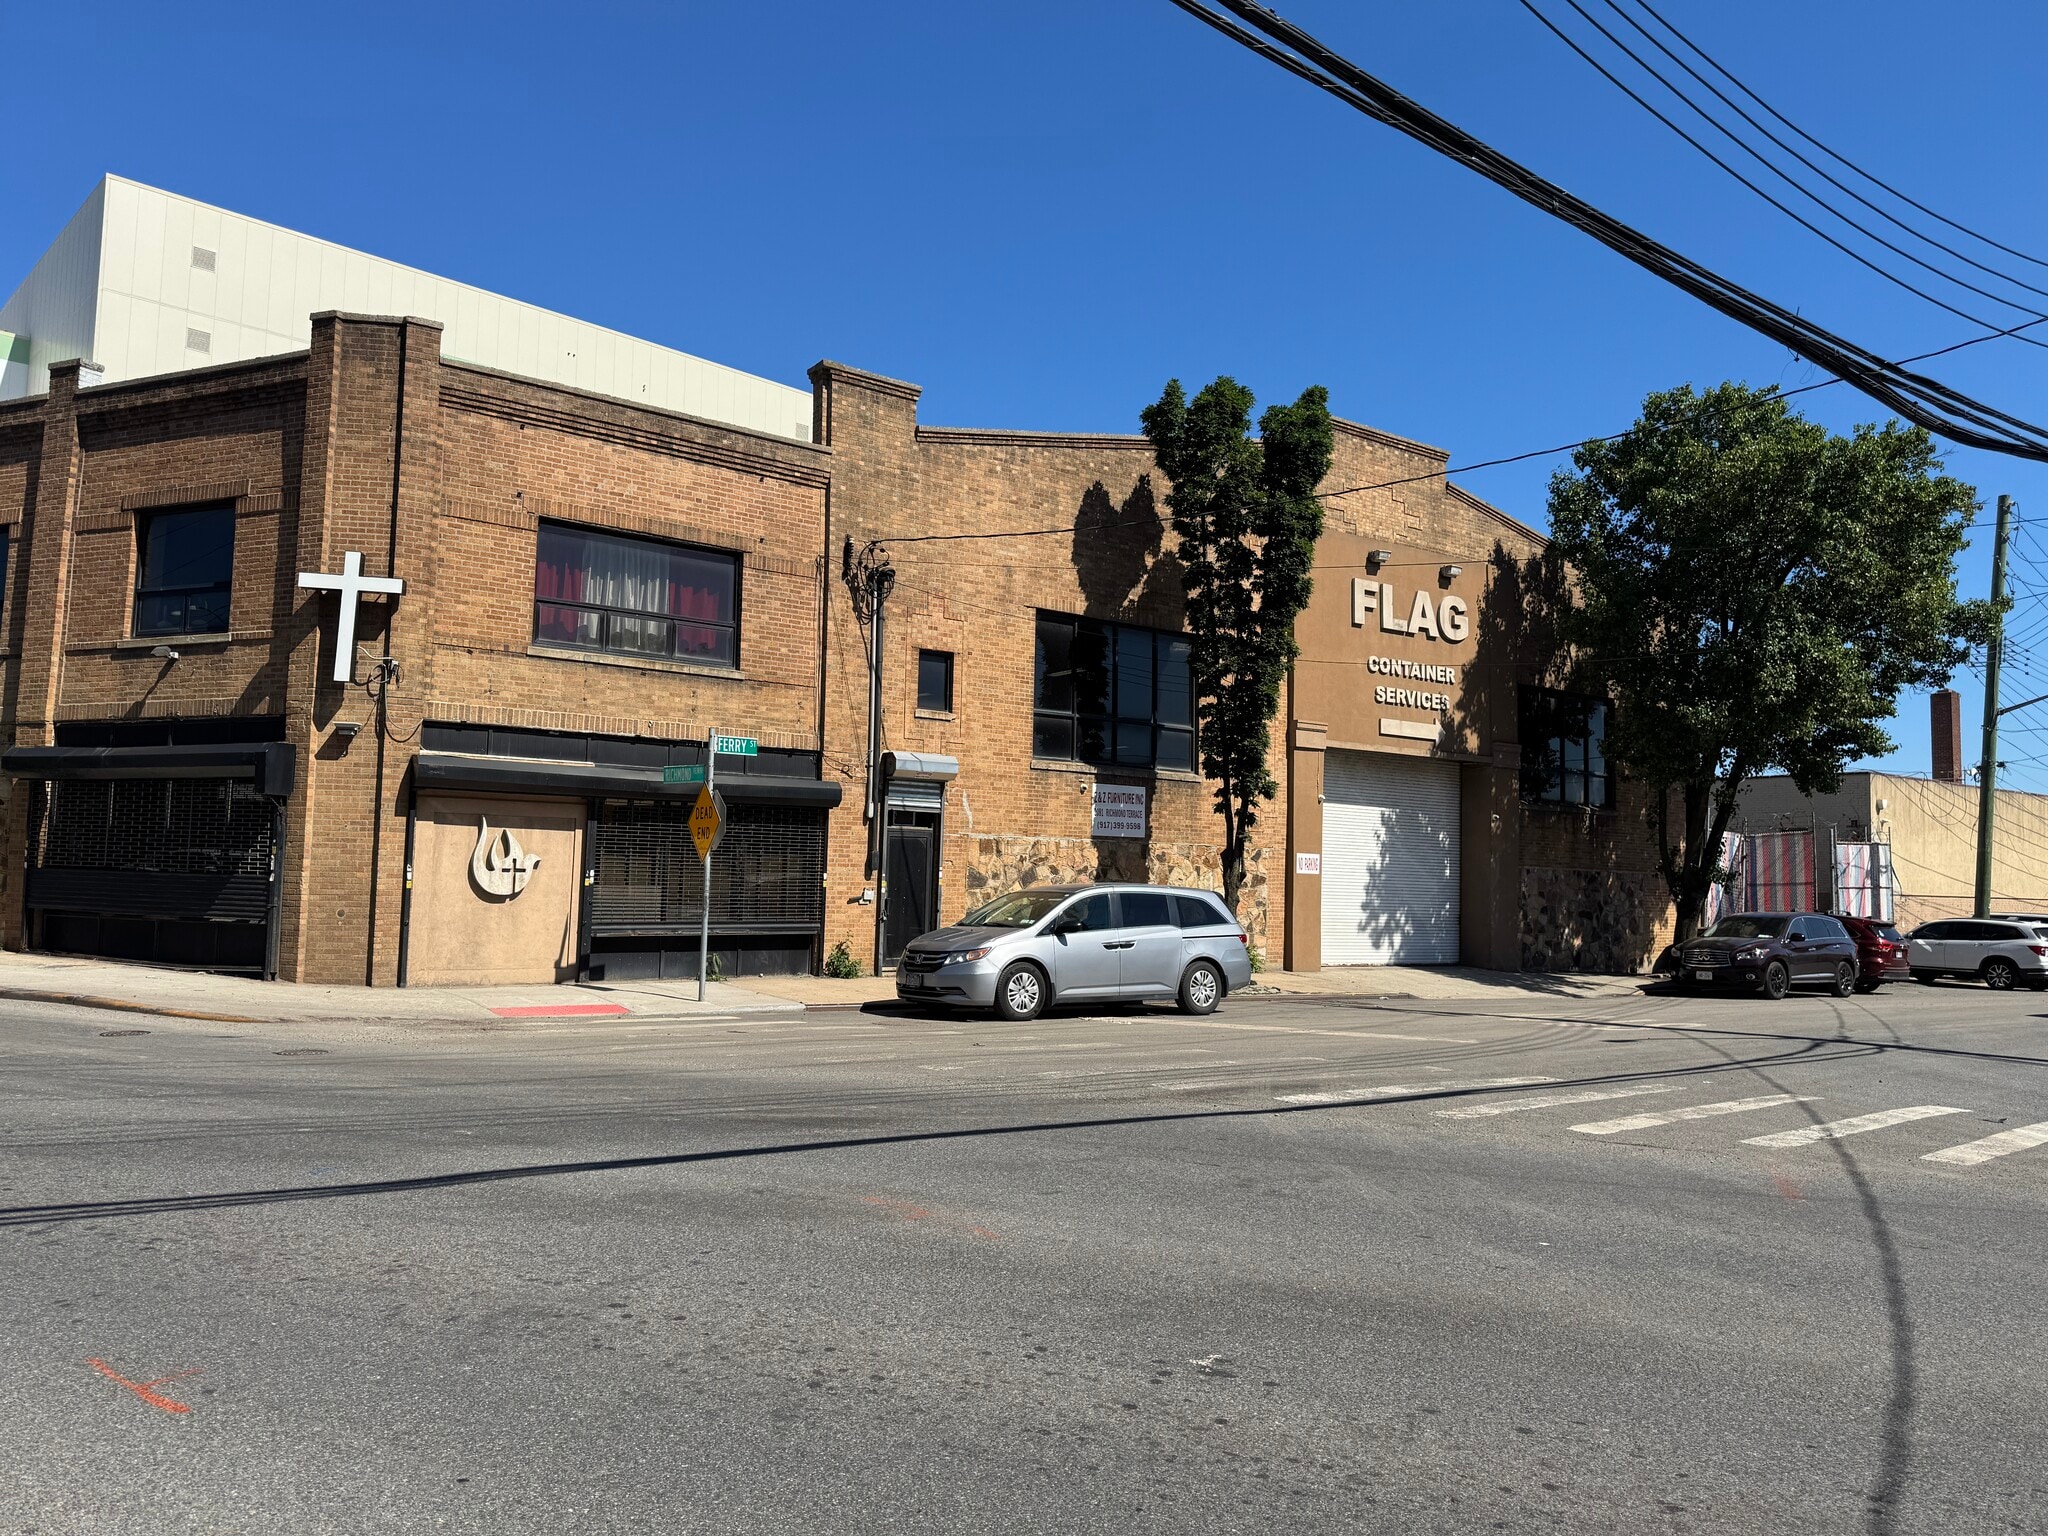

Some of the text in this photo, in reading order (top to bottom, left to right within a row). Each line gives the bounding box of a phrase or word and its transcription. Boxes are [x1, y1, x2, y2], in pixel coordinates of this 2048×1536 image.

[1353, 577, 1469, 643] FLAG
[1368, 655, 1456, 684] CONTAINER
[1375, 686, 1450, 710] SERVICES
[718, 738, 747, 752] FERRY
[665, 768, 692, 781] RICHMOND
[1107, 792, 1134, 805] FURNITURE
[1135, 793, 1144, 805] INC
[696, 806, 712, 820] DEAD
[1106, 808, 1126, 818] RICHMOND
[1127, 810, 1142, 818] TERRACE
[697, 826, 710, 840] END
